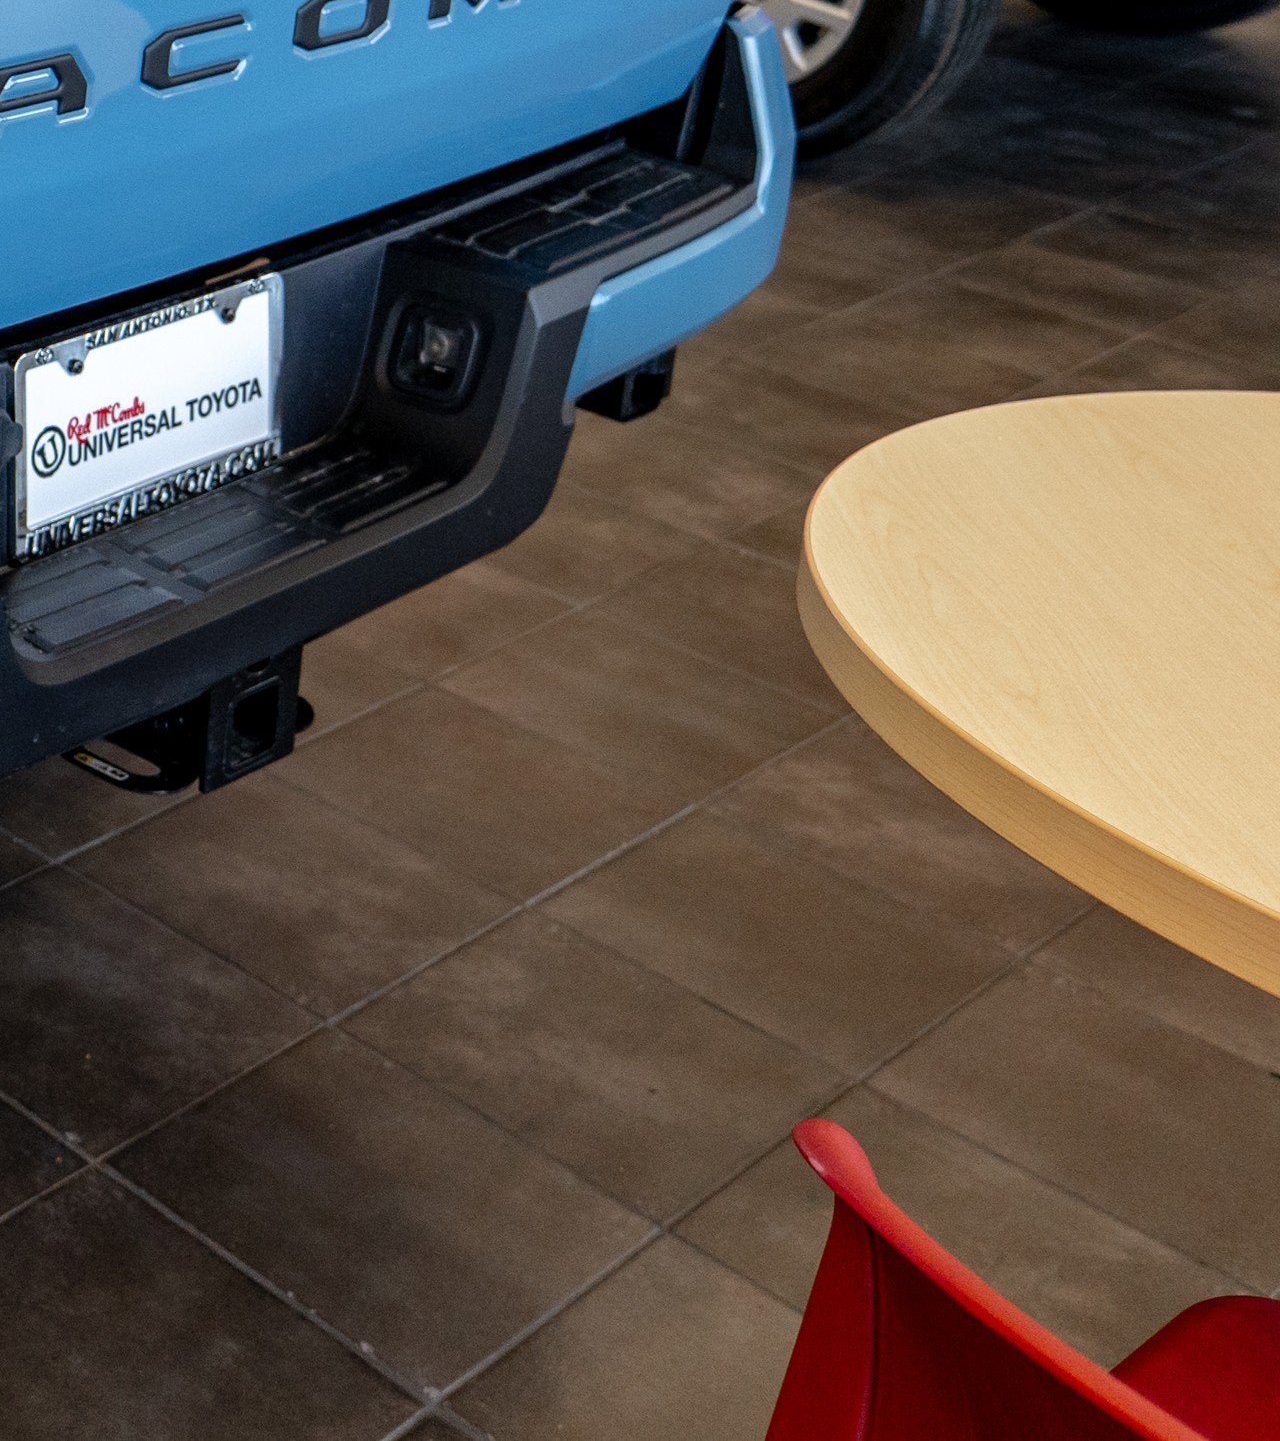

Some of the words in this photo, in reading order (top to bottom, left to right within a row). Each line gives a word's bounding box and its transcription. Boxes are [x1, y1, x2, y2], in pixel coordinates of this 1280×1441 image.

[85, 331, 117, 350] SAN
[67, 414, 92, 445] Red
[68, 406, 182, 466] UNIVERSAL
[186, 377, 262, 422] TOYOTA
